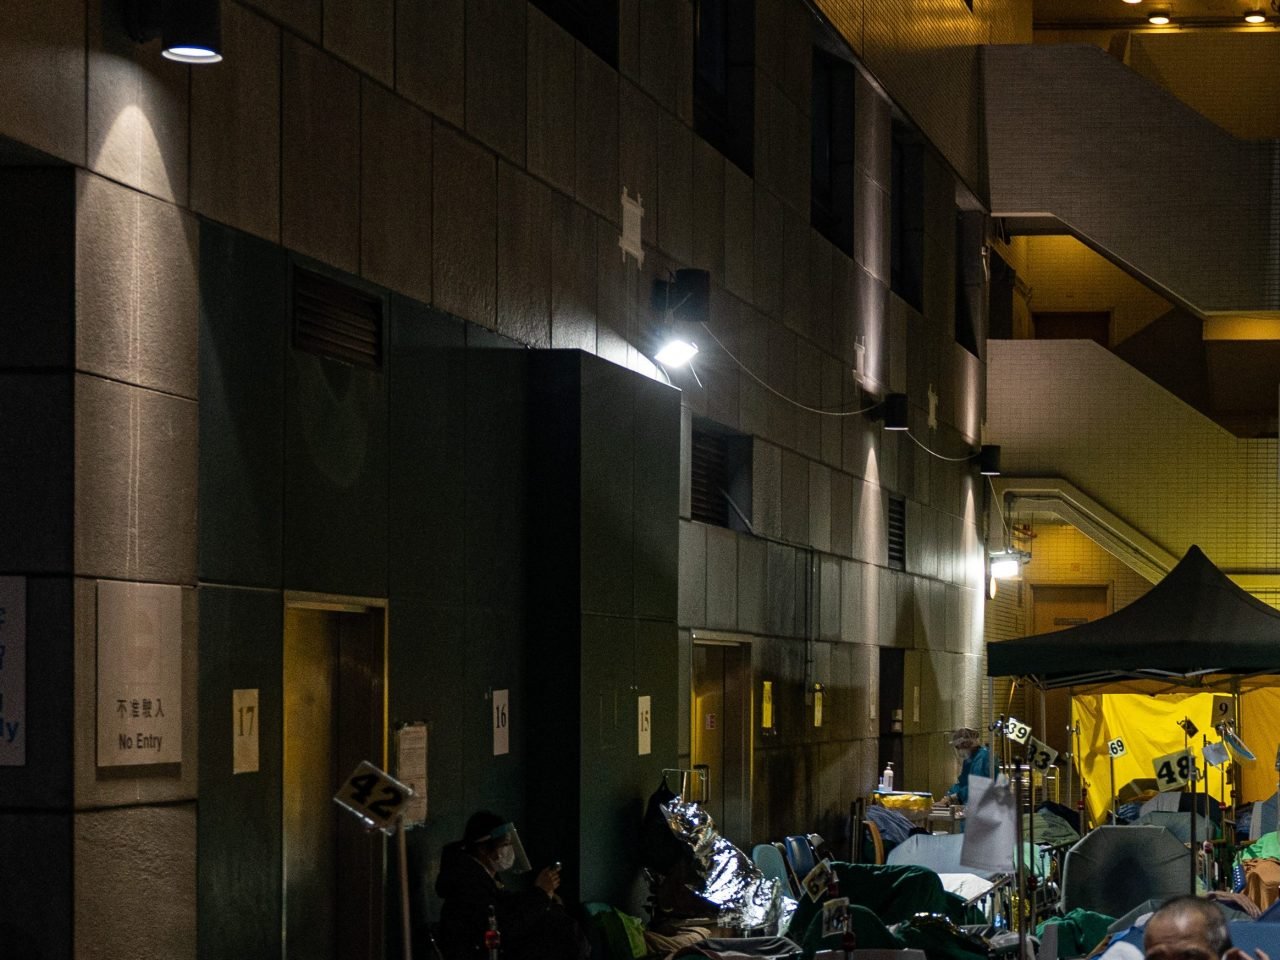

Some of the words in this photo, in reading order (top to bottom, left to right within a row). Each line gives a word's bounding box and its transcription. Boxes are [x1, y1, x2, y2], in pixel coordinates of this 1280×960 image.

[116, 698, 165, 718] 不准駛入
[495, 704, 507, 729] 16
[1219, 702, 1229, 715] 9
[237, 706, 256, 737] 17
[640, 710, 649, 732] 15
[1008, 722, 1027, 739] 39
[119, 733, 133, 749] No
[136, 733, 163, 752] Entry
[1110, 739, 1124, 755] 69
[1157, 756, 1190, 784] 48
[350, 773, 402, 820] 42
